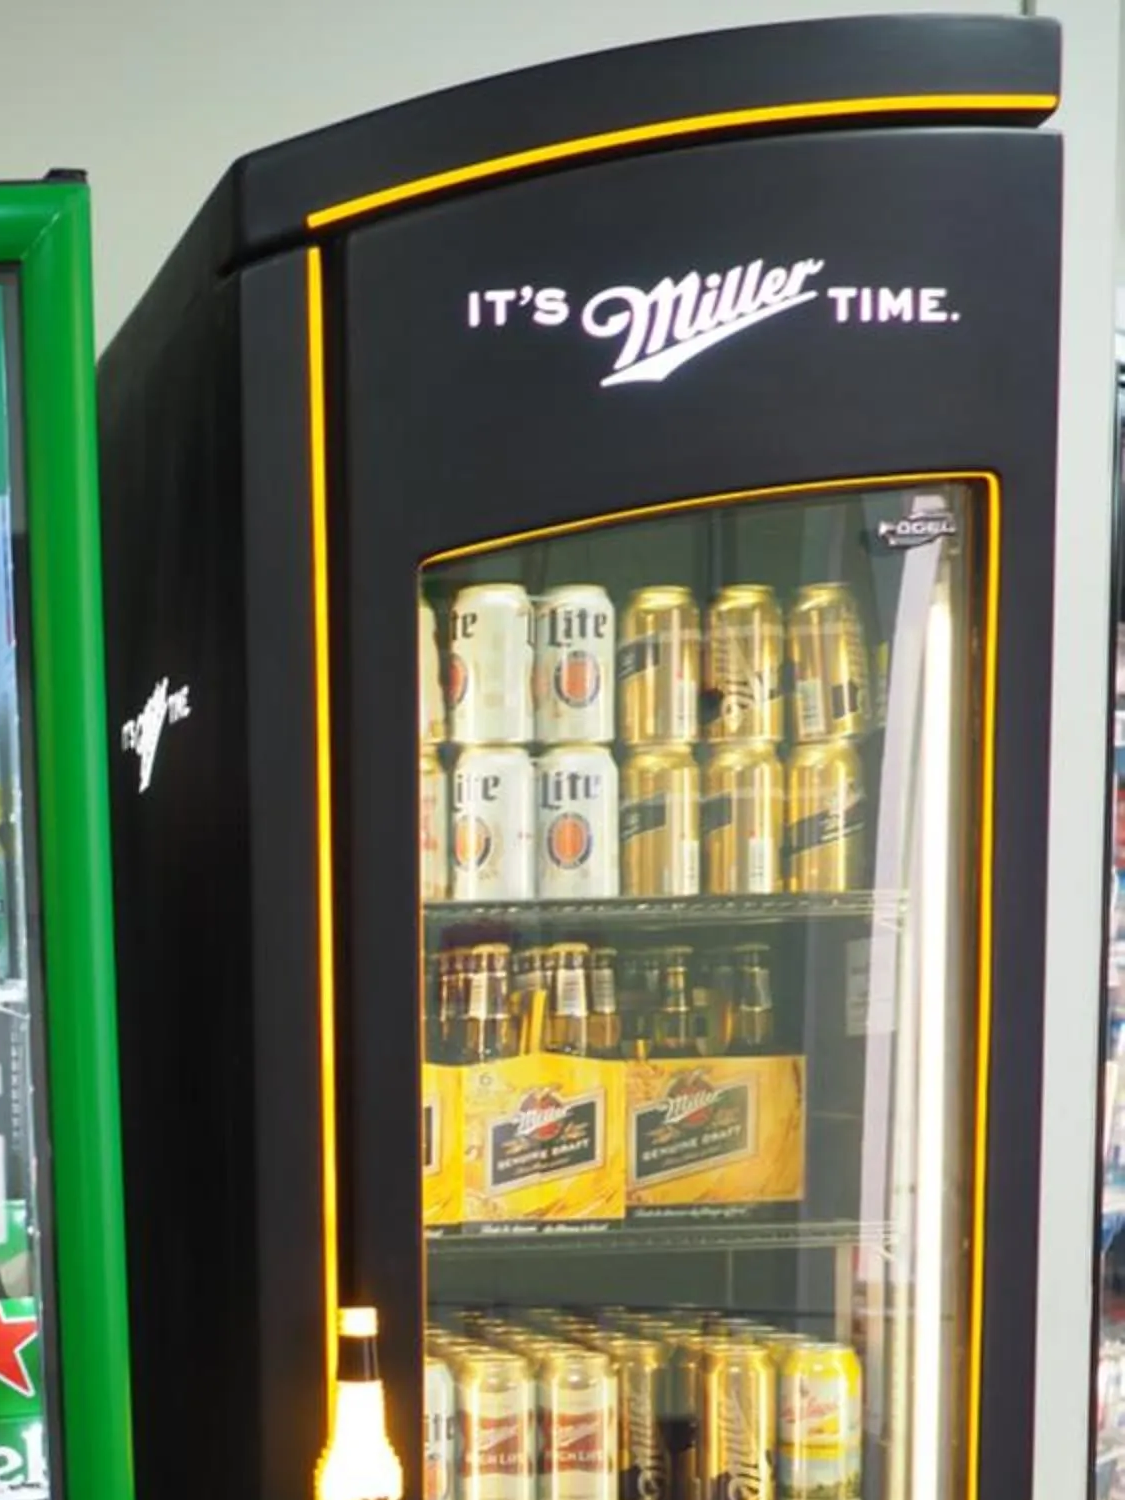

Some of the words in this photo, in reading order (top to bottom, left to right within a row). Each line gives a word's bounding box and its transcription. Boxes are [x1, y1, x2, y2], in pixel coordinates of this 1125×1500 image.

[468, 284, 570, 328] IT'S
[581, 259, 825, 387] Miller
[827, 286, 961, 324] TIME.
[547, 606, 609, 648] Lite
